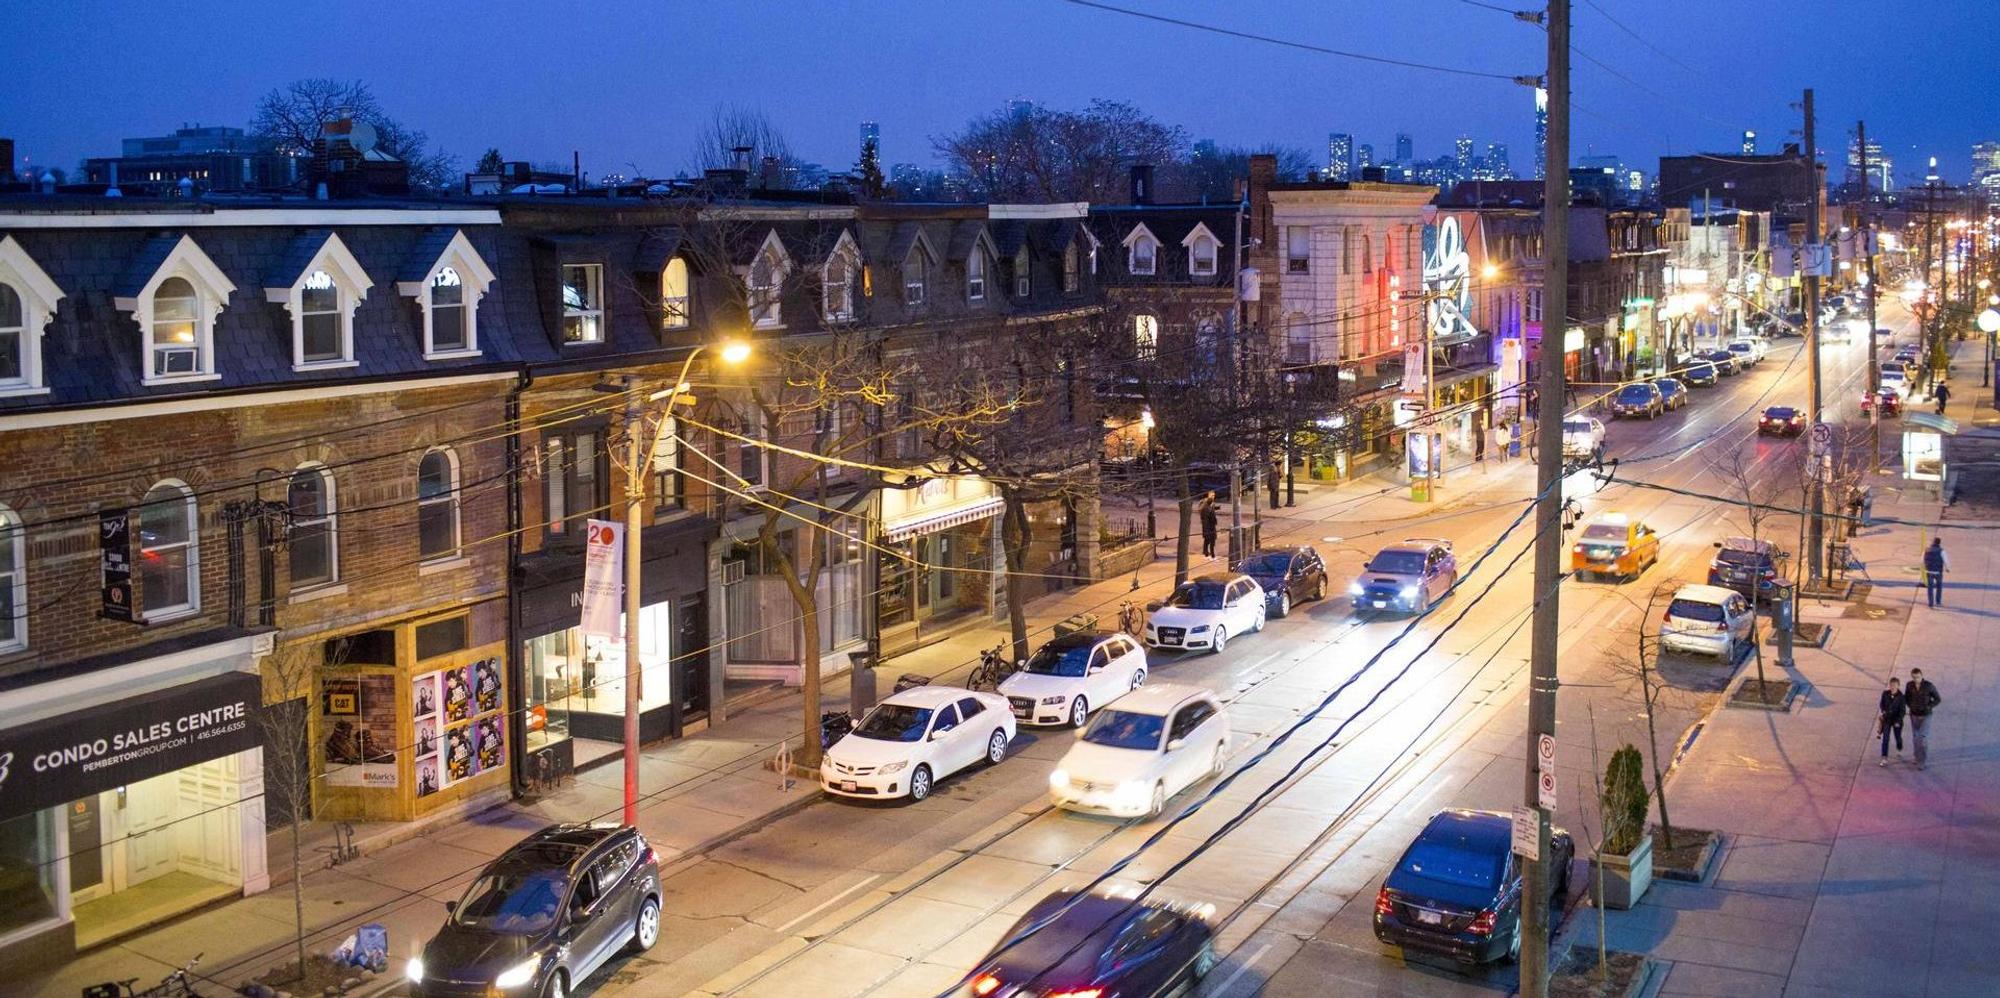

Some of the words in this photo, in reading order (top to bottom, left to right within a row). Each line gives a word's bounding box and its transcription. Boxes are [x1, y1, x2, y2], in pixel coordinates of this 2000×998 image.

[334, 698, 350, 709] CAT
[33, 739, 108, 772] CONDO
[113, 721, 172, 751] SALES
[176, 701, 245, 733] CENTRE
[83, 737, 187, 773] PEMBERTONGROUPCOM
[367, 772, 396, 781] Mark's
